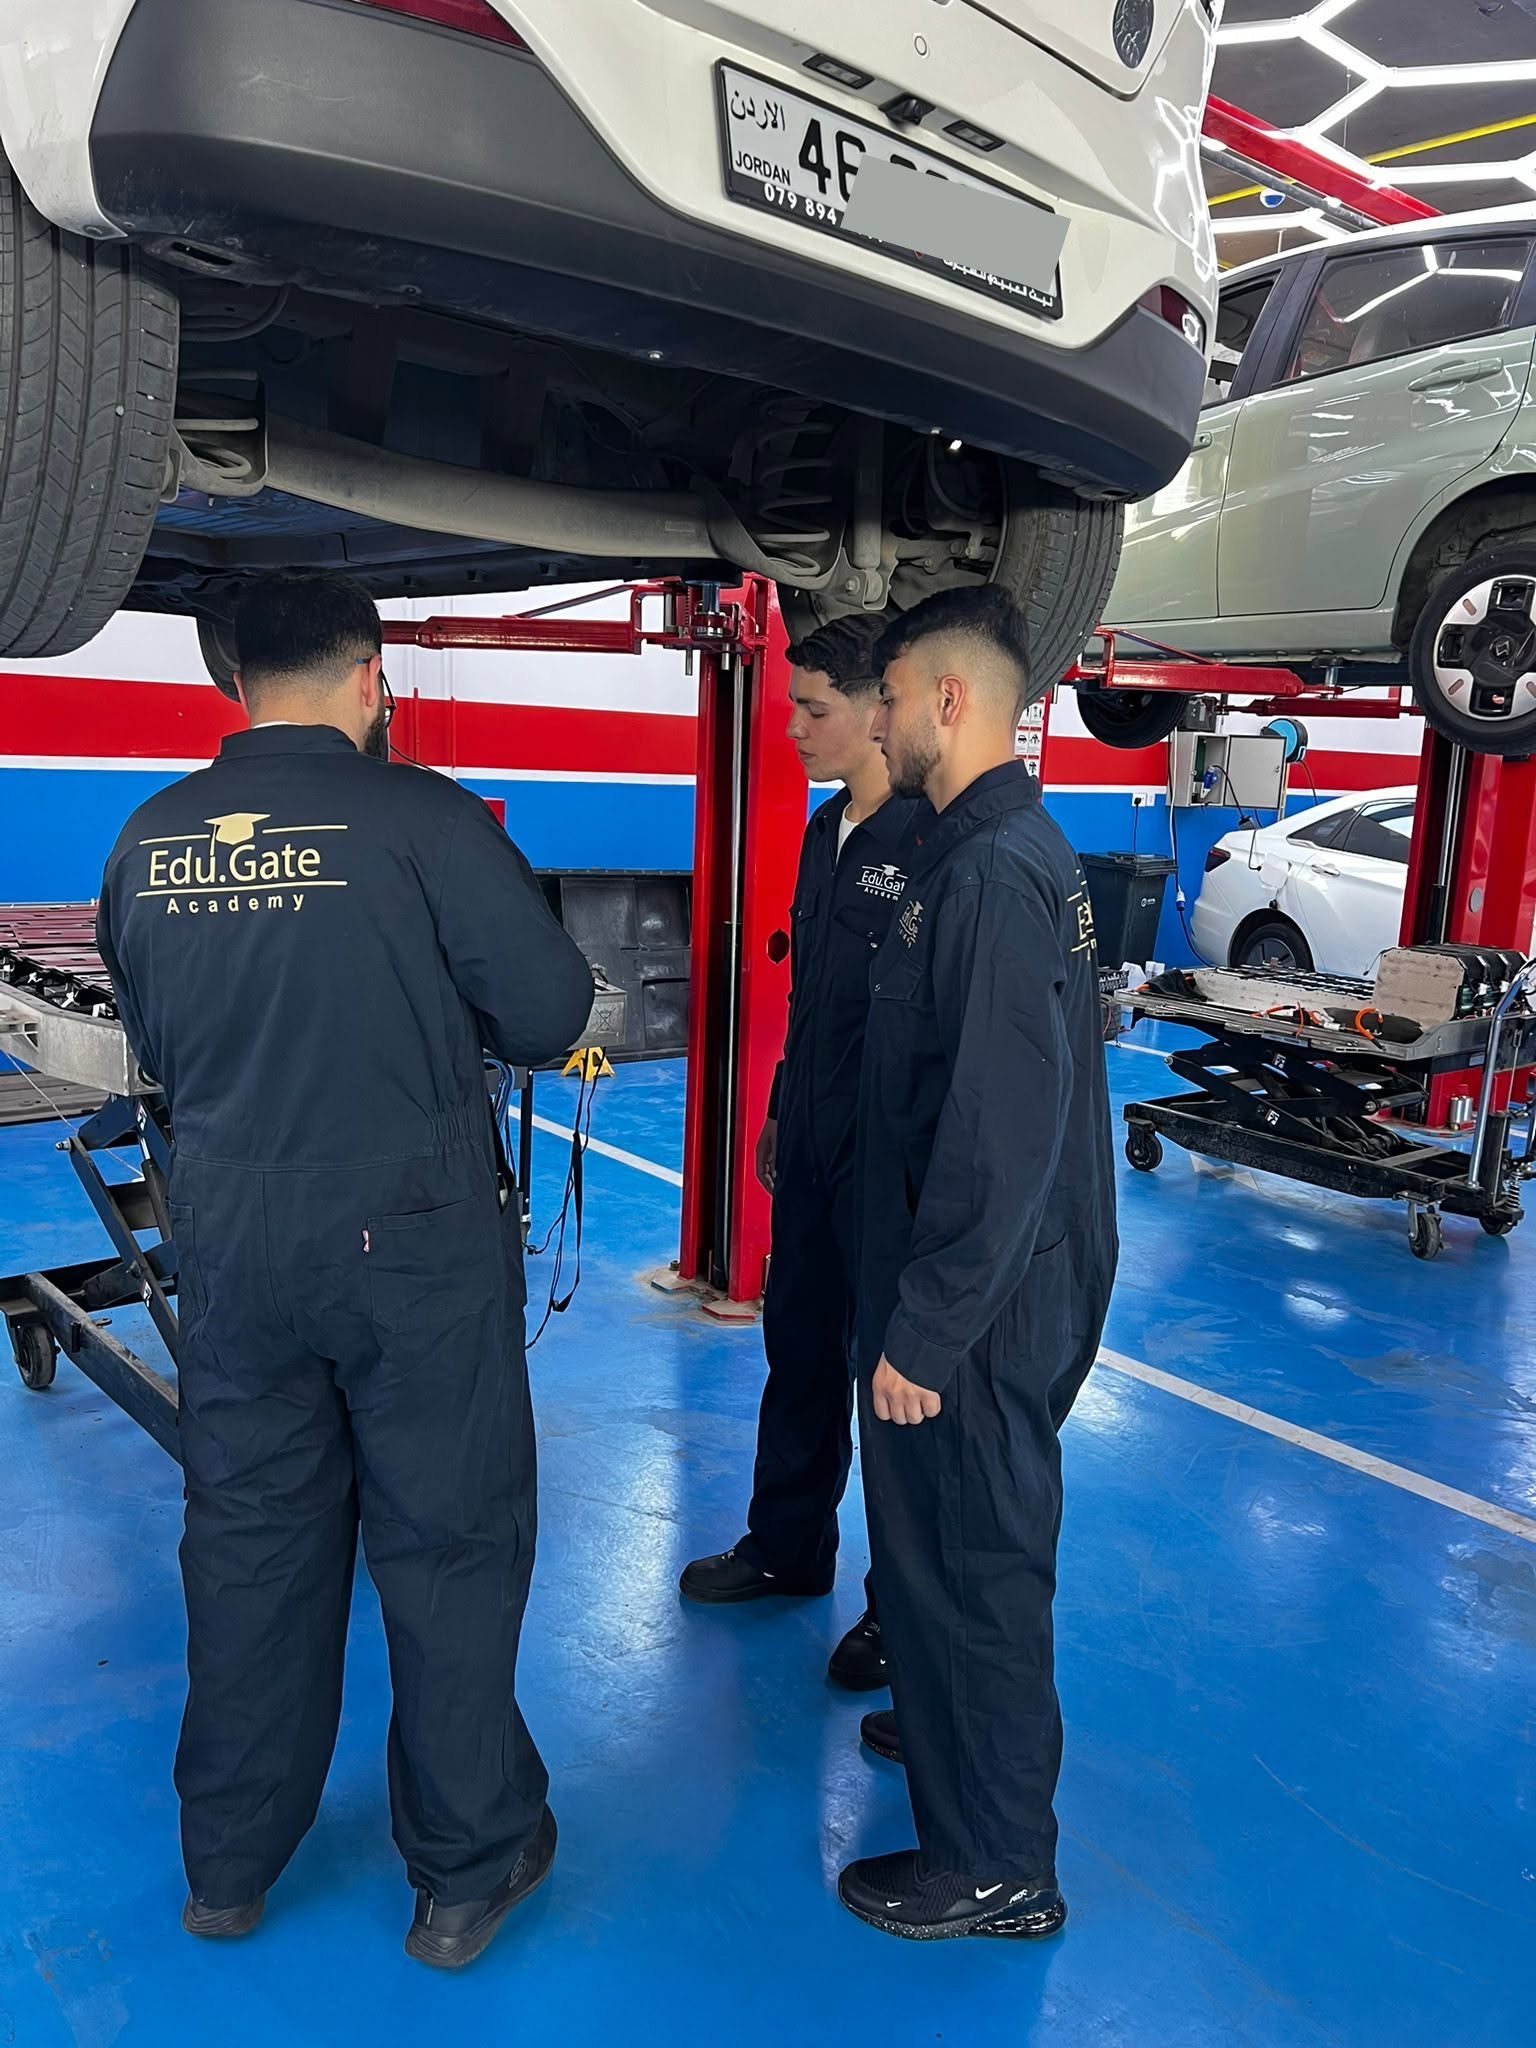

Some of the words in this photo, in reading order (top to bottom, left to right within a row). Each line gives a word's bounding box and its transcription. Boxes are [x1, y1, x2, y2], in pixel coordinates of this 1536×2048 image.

[735, 150, 791, 186] JORDAN
[763, 183, 797, 210] 079
[806, 201, 837, 225] 894
[150, 843, 321, 886] Edu.Gate
[167, 894, 304, 914] Academy
